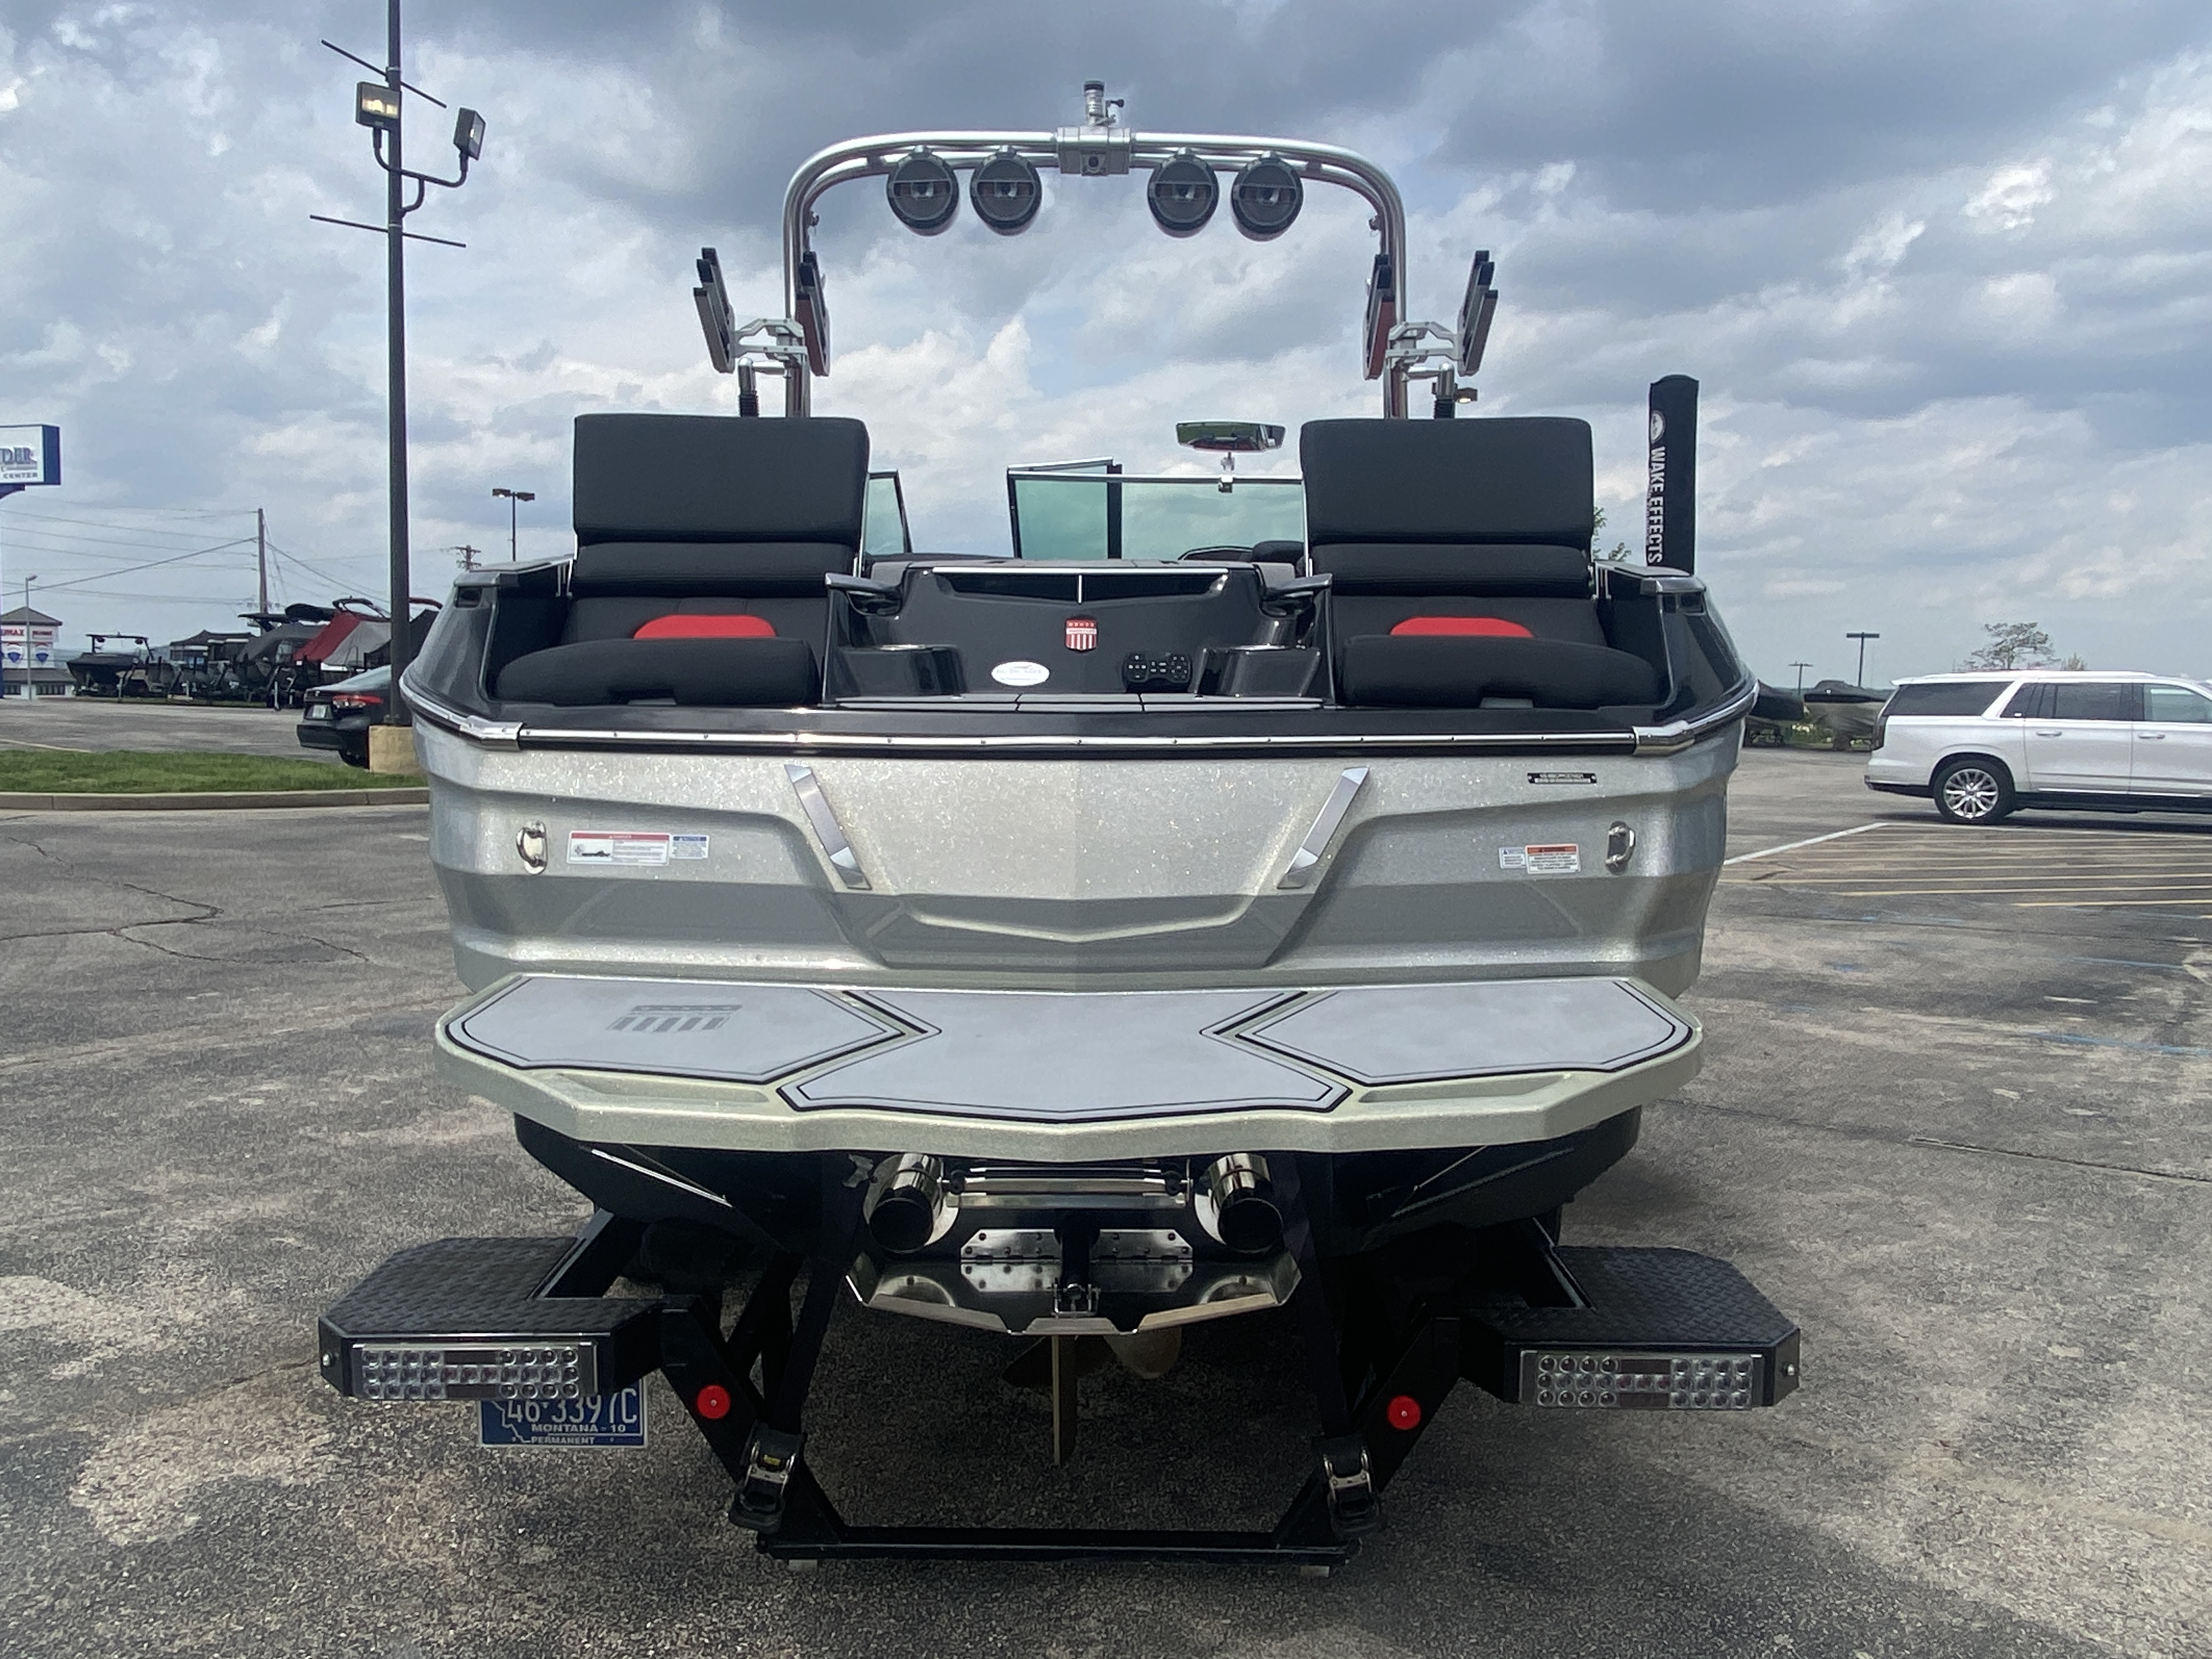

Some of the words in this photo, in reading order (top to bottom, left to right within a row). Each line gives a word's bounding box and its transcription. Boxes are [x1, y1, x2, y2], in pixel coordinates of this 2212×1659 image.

[1650, 446, 1666, 493] WAKE
[1647, 496, 1664, 563] EFFECTS
[531, 1424, 598, 1433] MONTANA
[531, 1436, 595, 1444] PERMANENT
